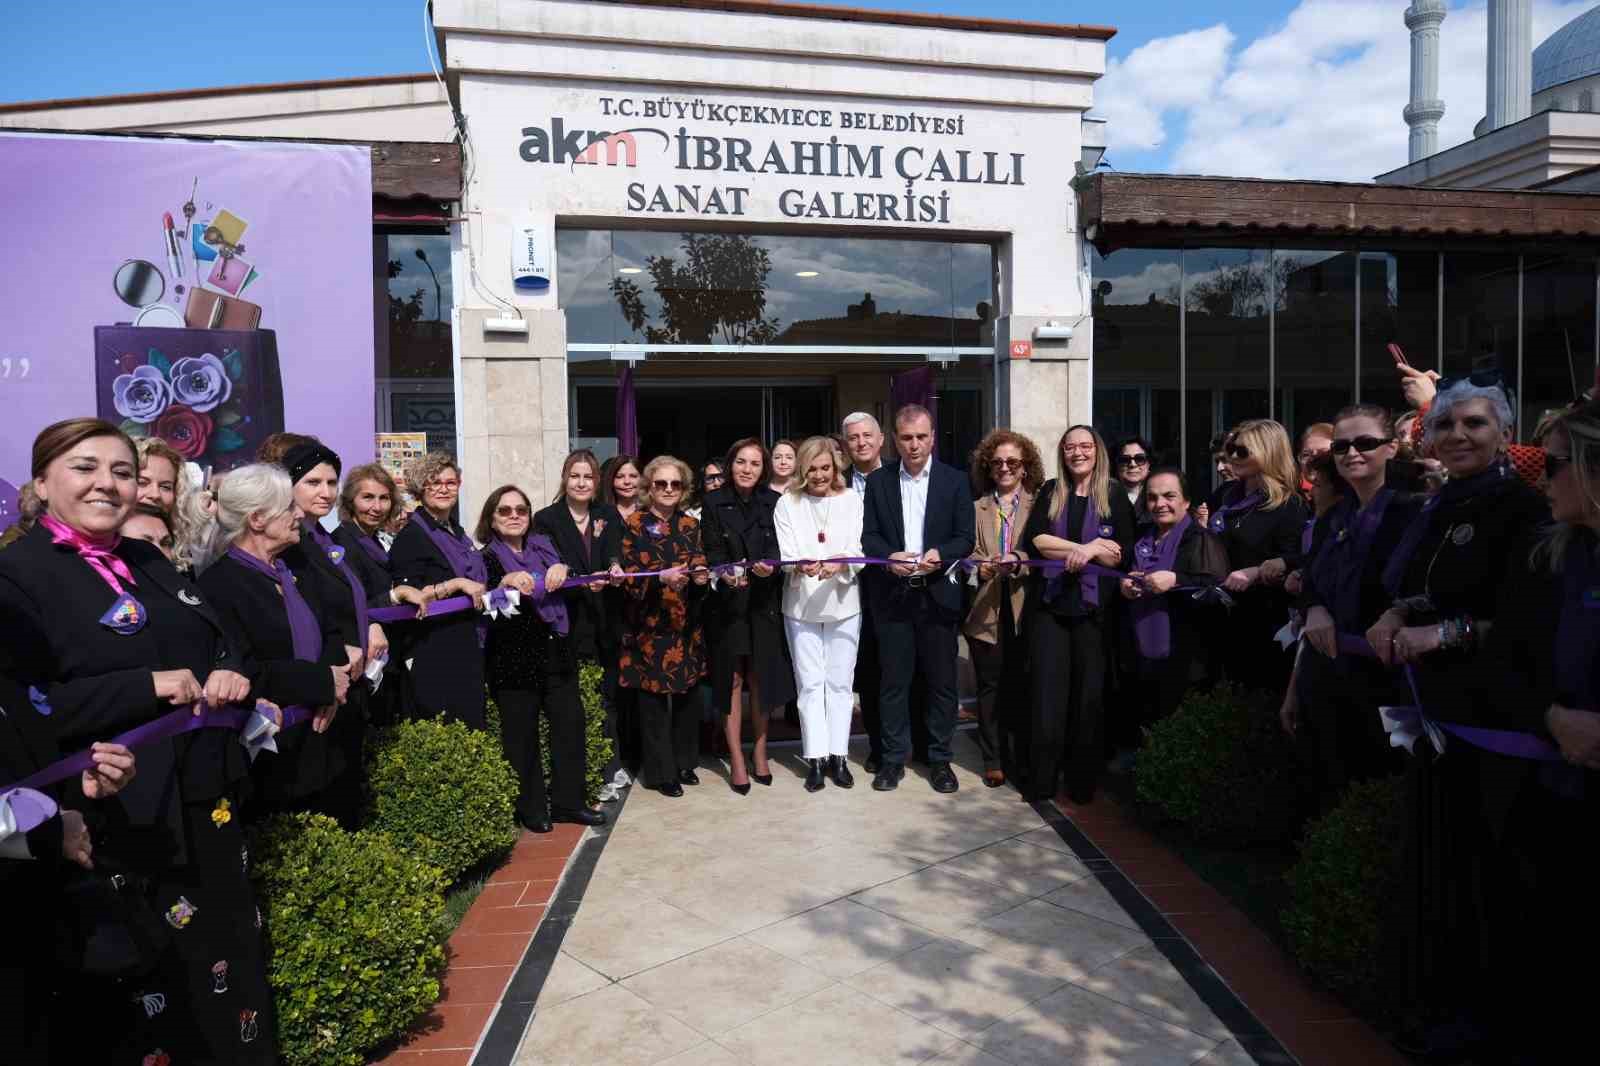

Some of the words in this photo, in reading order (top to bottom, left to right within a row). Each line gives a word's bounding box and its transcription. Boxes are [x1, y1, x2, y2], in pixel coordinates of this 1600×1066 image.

[600, 97, 640, 117] T.C.
[643, 97, 832, 127] BÜYÜKÇEKMECE
[840, 111, 965, 136] BELEDİYESİ
[519, 117, 637, 168] akm
[674, 126, 885, 179] İBRAHİM
[894, 146, 1026, 188] ÇALLI
[627, 182, 750, 215] SANAT
[778, 188, 951, 223] GALERİSİ
